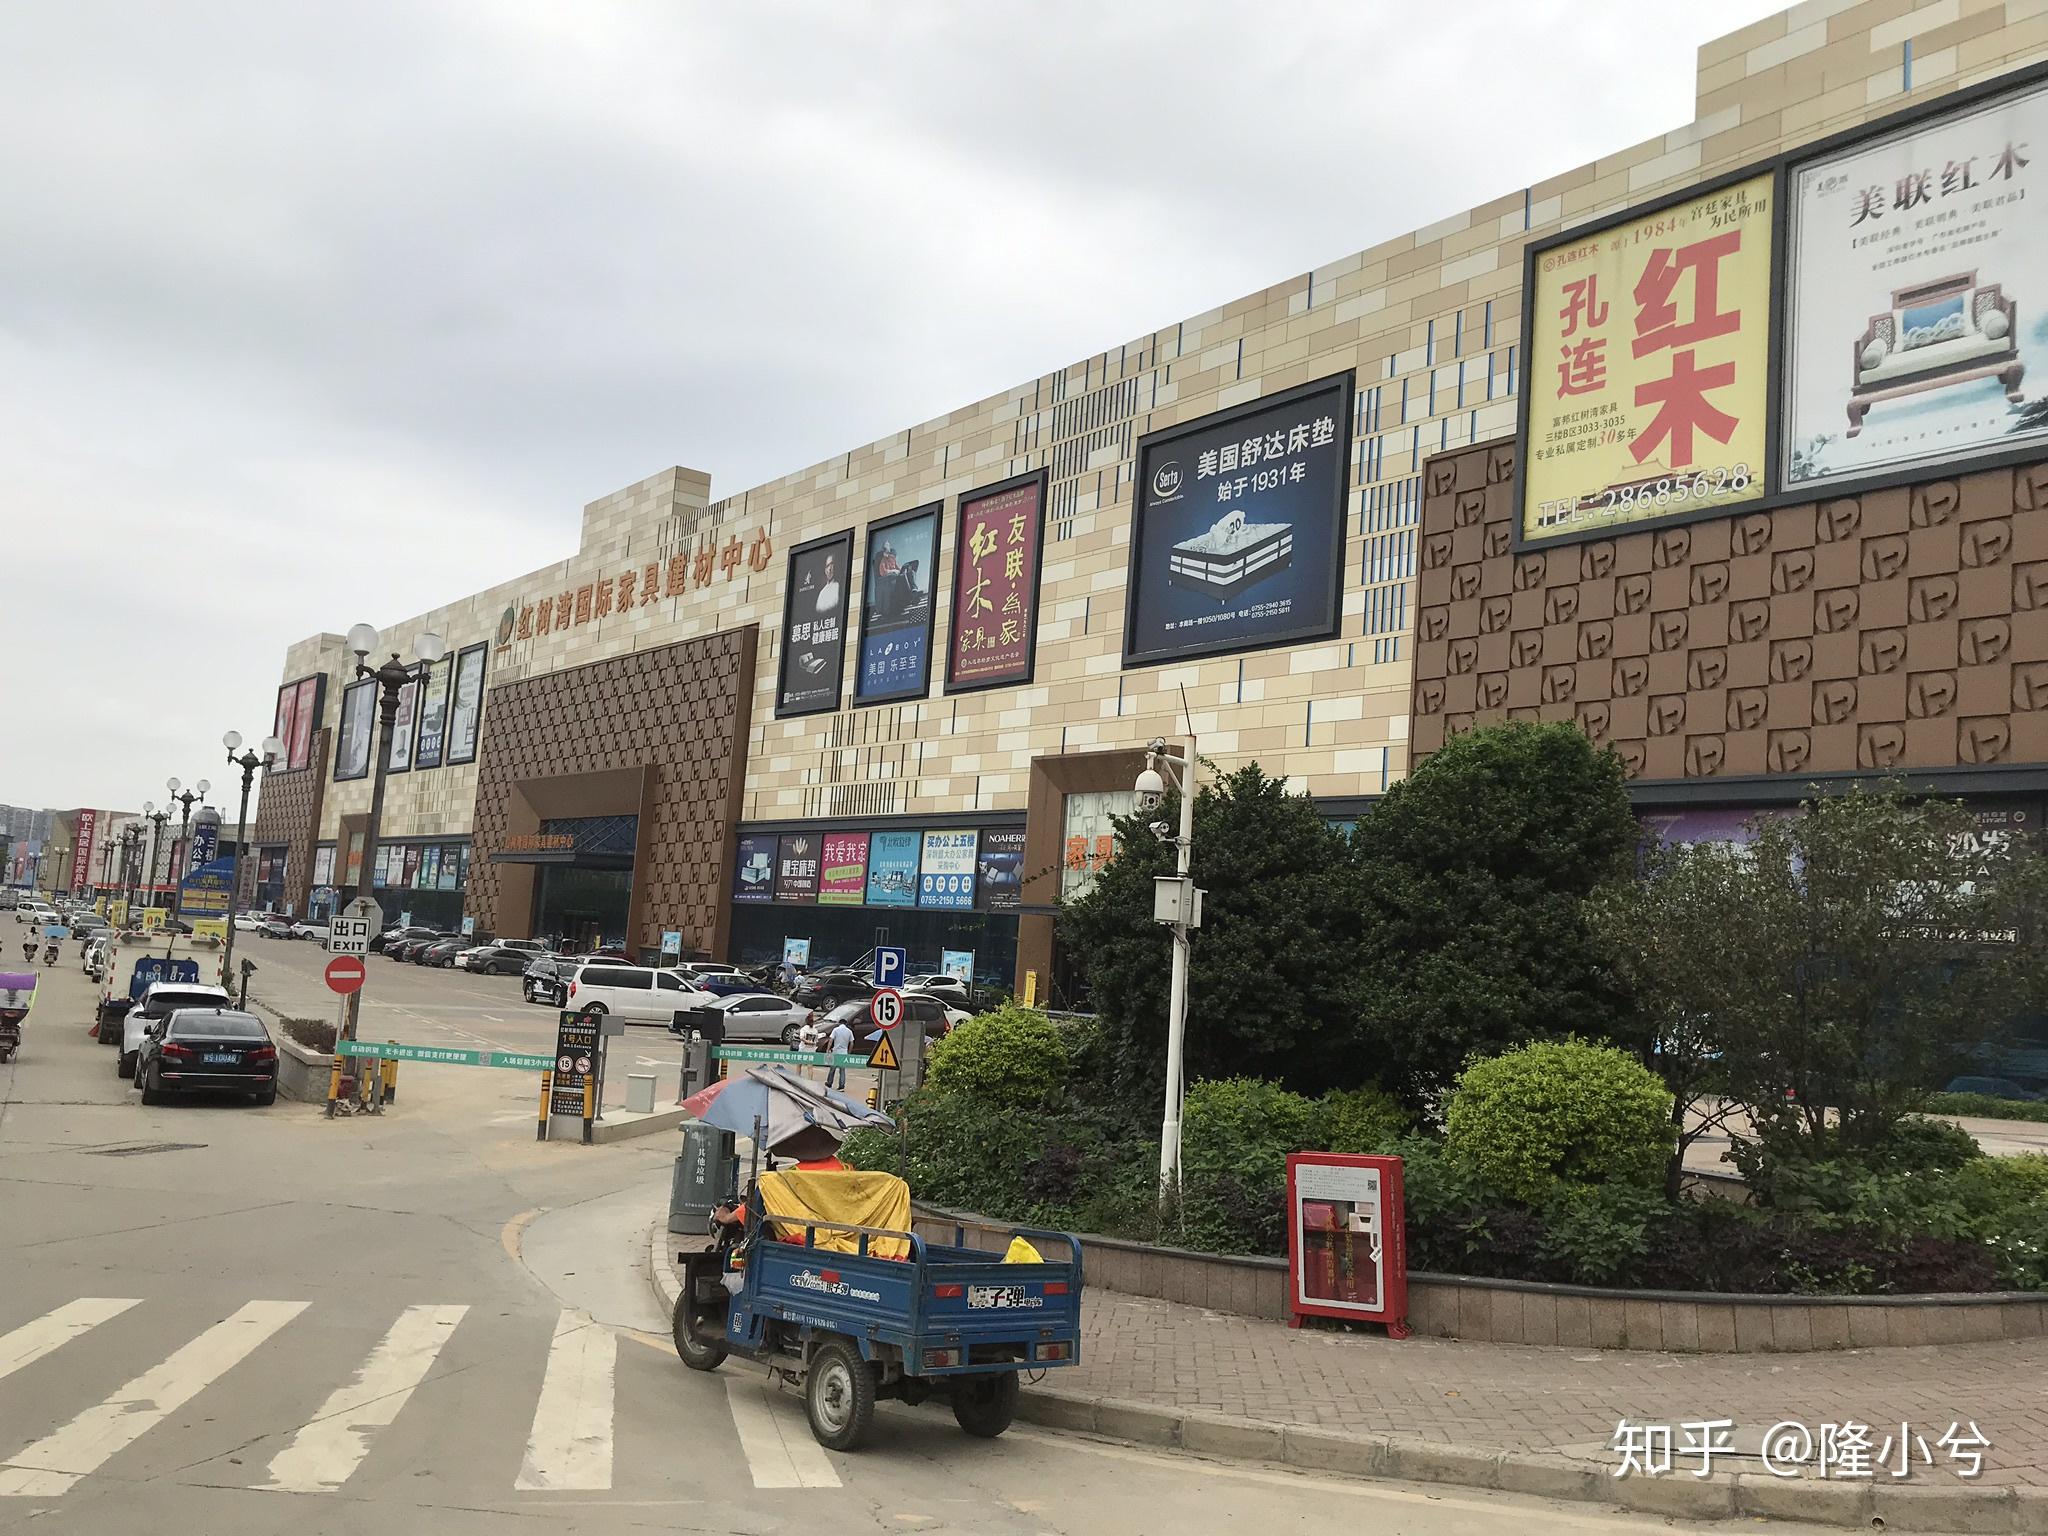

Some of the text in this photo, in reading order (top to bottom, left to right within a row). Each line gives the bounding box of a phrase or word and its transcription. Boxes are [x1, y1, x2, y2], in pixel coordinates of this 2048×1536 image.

[1849, 140, 2031, 229] 美联红木
[1710, 198, 1767, 229] 为民所用
[1556, 243, 1600, 268] 孔连红木
[1557, 273, 1610, 401] 孔连
[1628, 229, 1742, 469] 红木
[1552, 401, 1619, 428] 富邦红树湾家具
[1197, 415, 1336, 480] 美国舒达床垫
[1159, 470, 1179, 488] Serta
[1217, 461, 1306, 503] 始于1931年
[1229, 518, 1242, 535] 20
[516, 524, 773, 641] 红树湾国际家具建材中心
[791, 622, 811, 643] 慕思
[813, 616, 836, 633] 私人定制
[824, 840, 867, 864] 我爱我家
[927, 835, 950, 849] 买办公
[951, 833, 976, 849] 上五楼
[1067, 834, 1114, 872] 家具
[920, 894, 954, 906] 0755-2150
[333, 920, 368, 937] 出口
[333, 940, 364, 951] EXIT
[881, 951, 899, 983] P
[877, 996, 896, 1021] 15
[562, 1034, 592, 1044] 1号入口
[561, 1060, 570, 1068] 15
[695, 1148, 706, 1185] 其他垃圾
